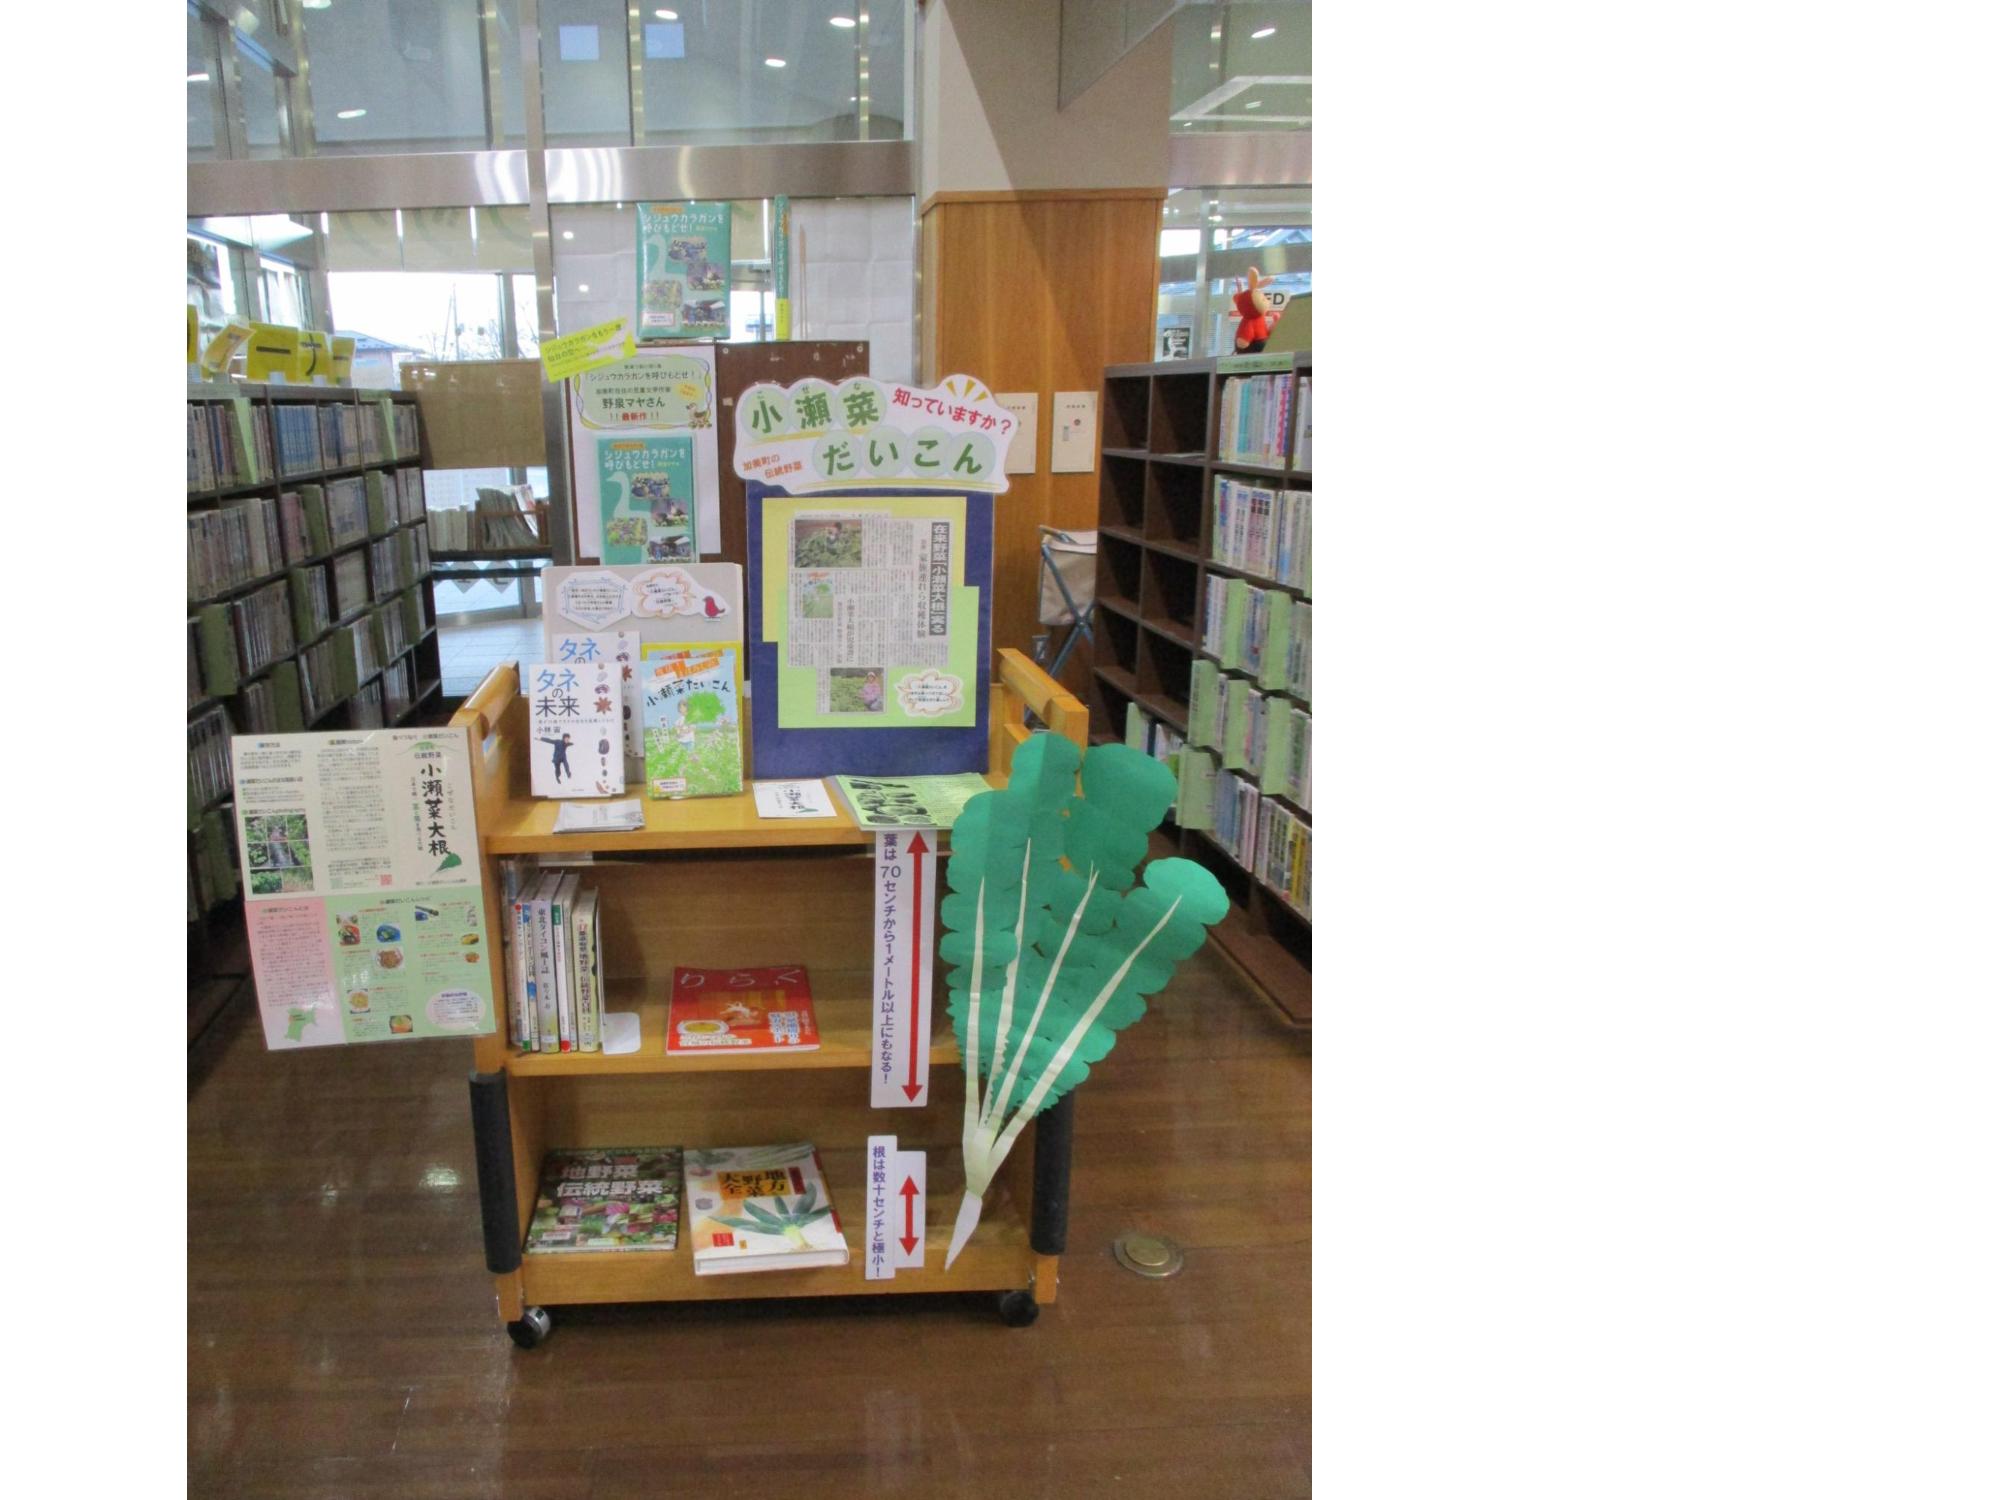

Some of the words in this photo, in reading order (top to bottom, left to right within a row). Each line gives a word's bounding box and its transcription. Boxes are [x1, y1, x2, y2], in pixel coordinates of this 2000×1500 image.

[644, 213, 725, 225] シジュウカラガンを
[602, 397, 665, 409] 野泉マヤさん
[752, 389, 880, 433] 小瀬菜
[892, 387, 1012, 435] 知っていますか？
[604, 448, 686, 460] シジュウカラガンを
[823, 437, 982, 476] だいこん
[536, 696, 580, 717] 未来
[420, 763, 451, 856] 小瀬菜大根
[680, 968, 801, 988] りらく
[556, 1180, 664, 1198] 伝統野菜
[872, 1146, 886, 1277] 根は数十センチと極小！
